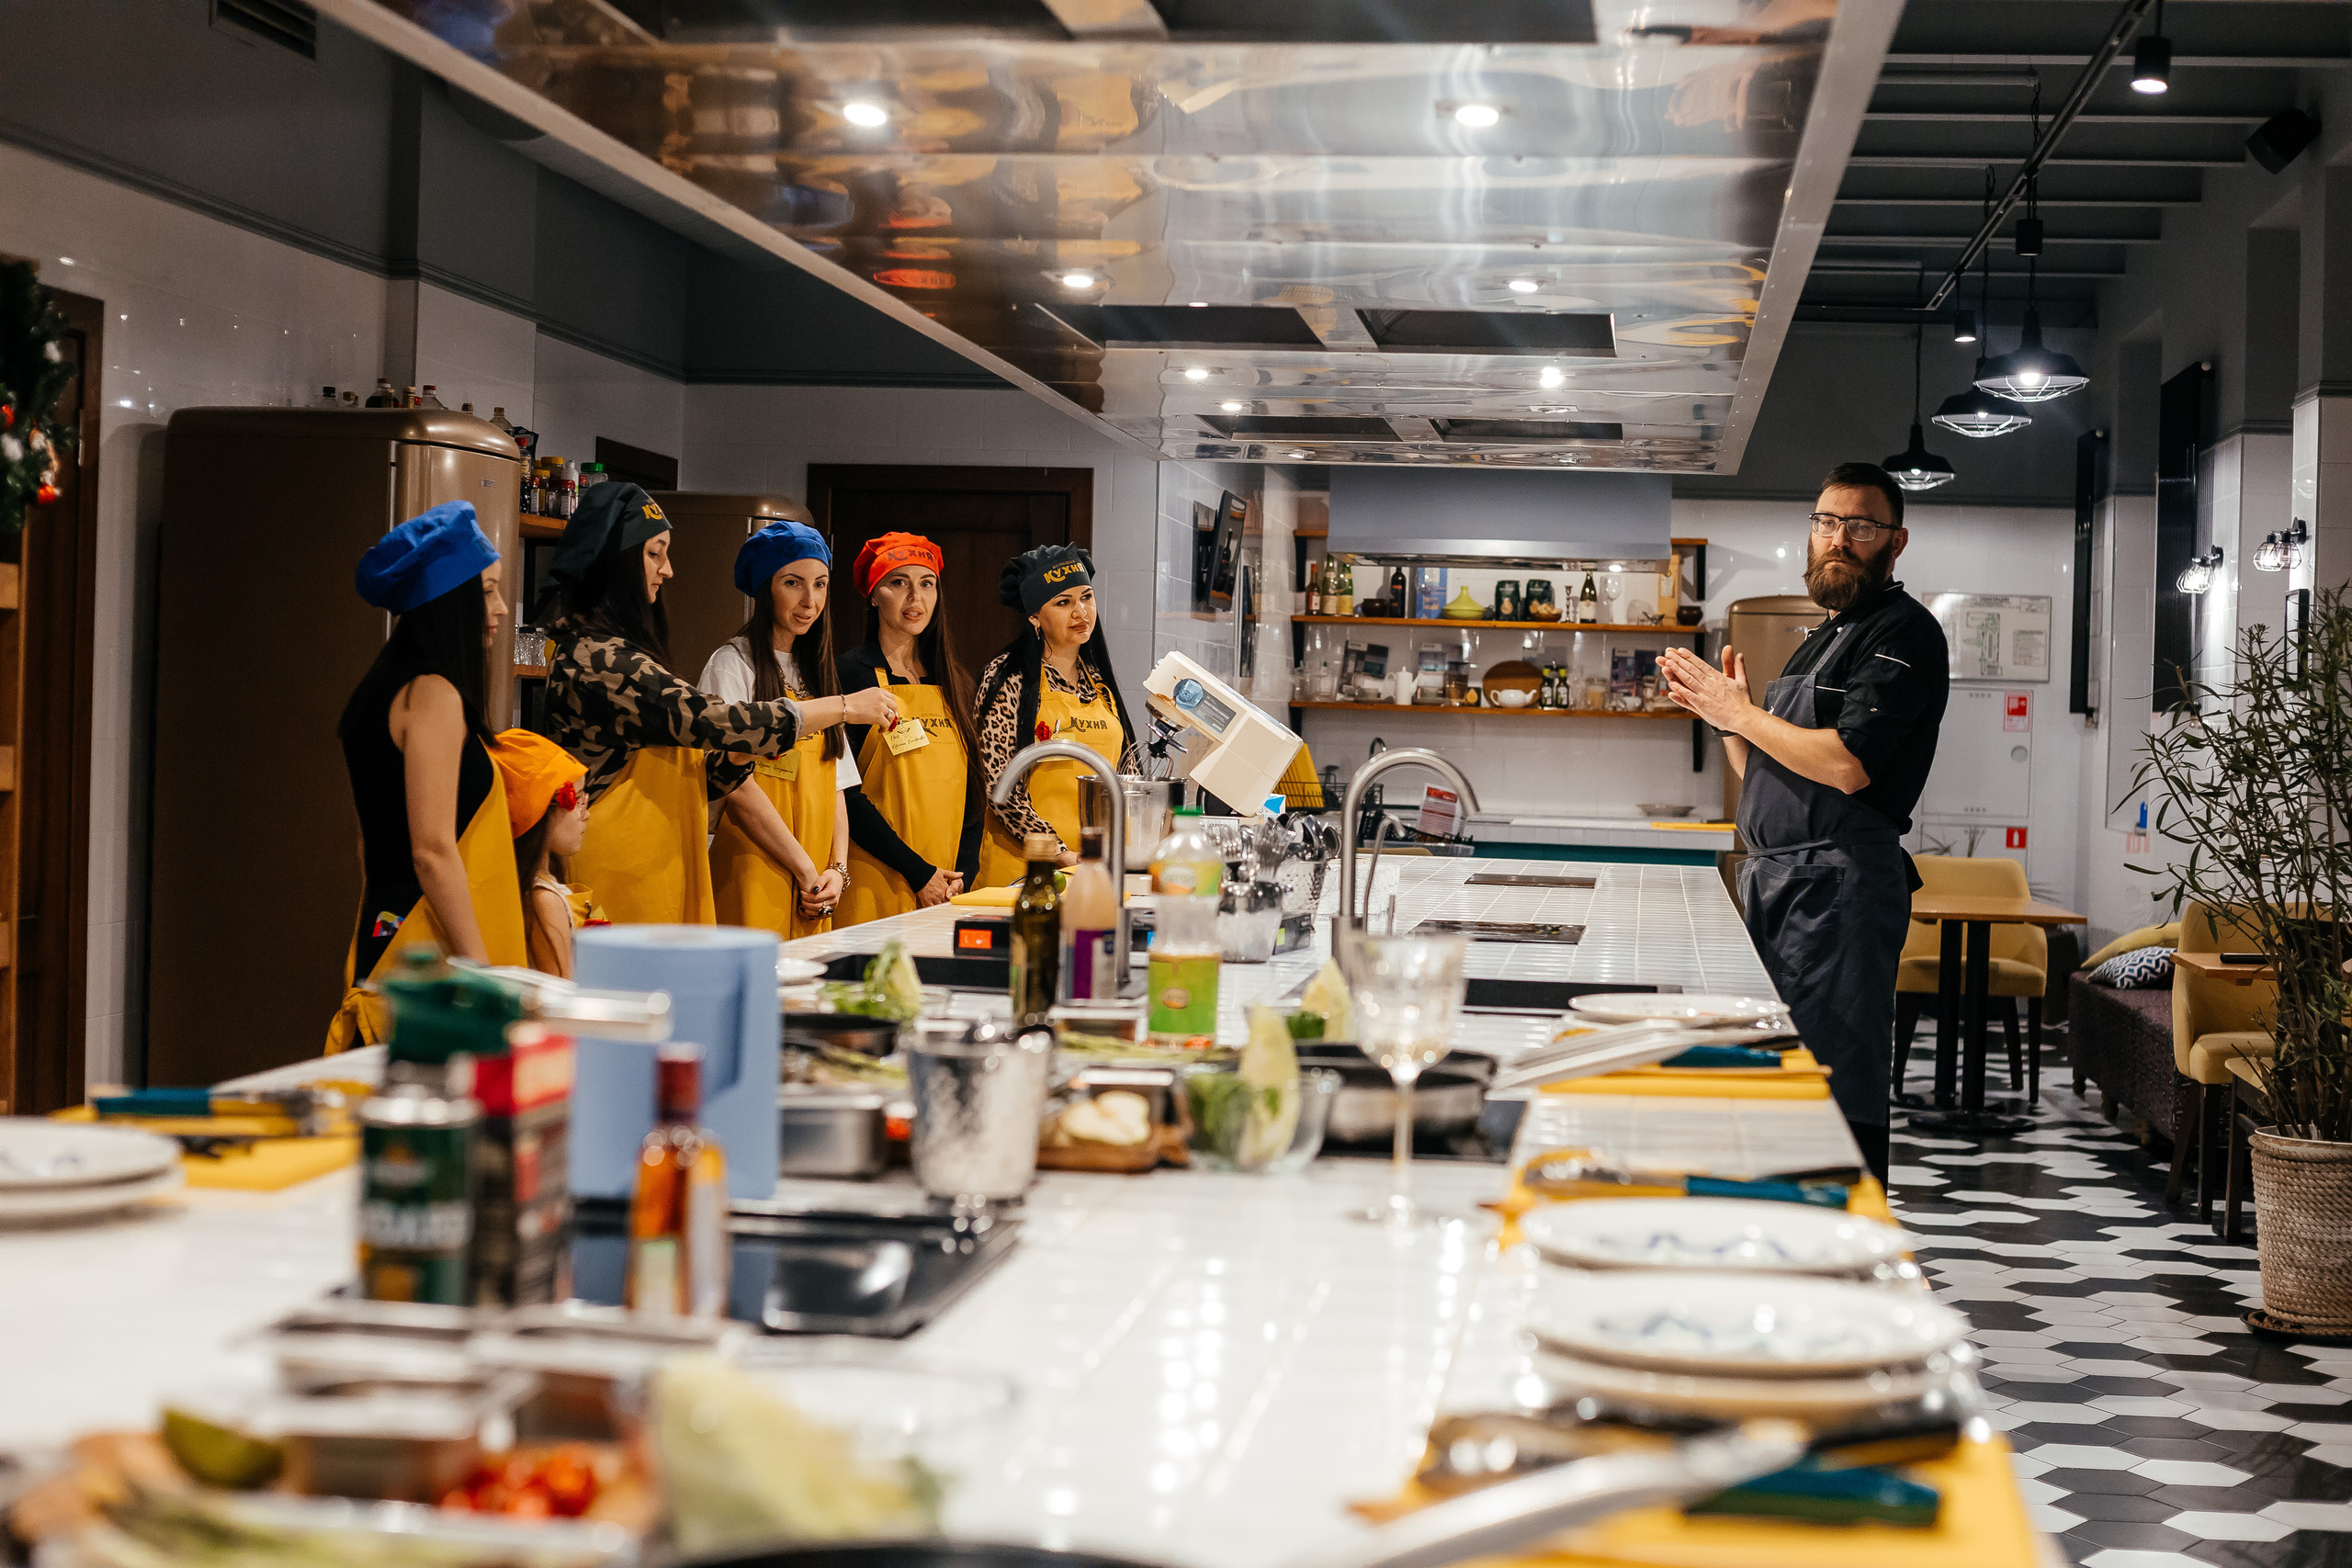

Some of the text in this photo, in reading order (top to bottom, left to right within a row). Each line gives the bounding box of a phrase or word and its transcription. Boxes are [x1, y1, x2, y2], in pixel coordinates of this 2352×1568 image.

[888, 549, 933, 562] КУХНЯ
[1044, 562, 1085, 584] КУХНЯ
[911, 716, 952, 732] УХНЯ
[1070, 716, 1108, 733] КУХНЯ
